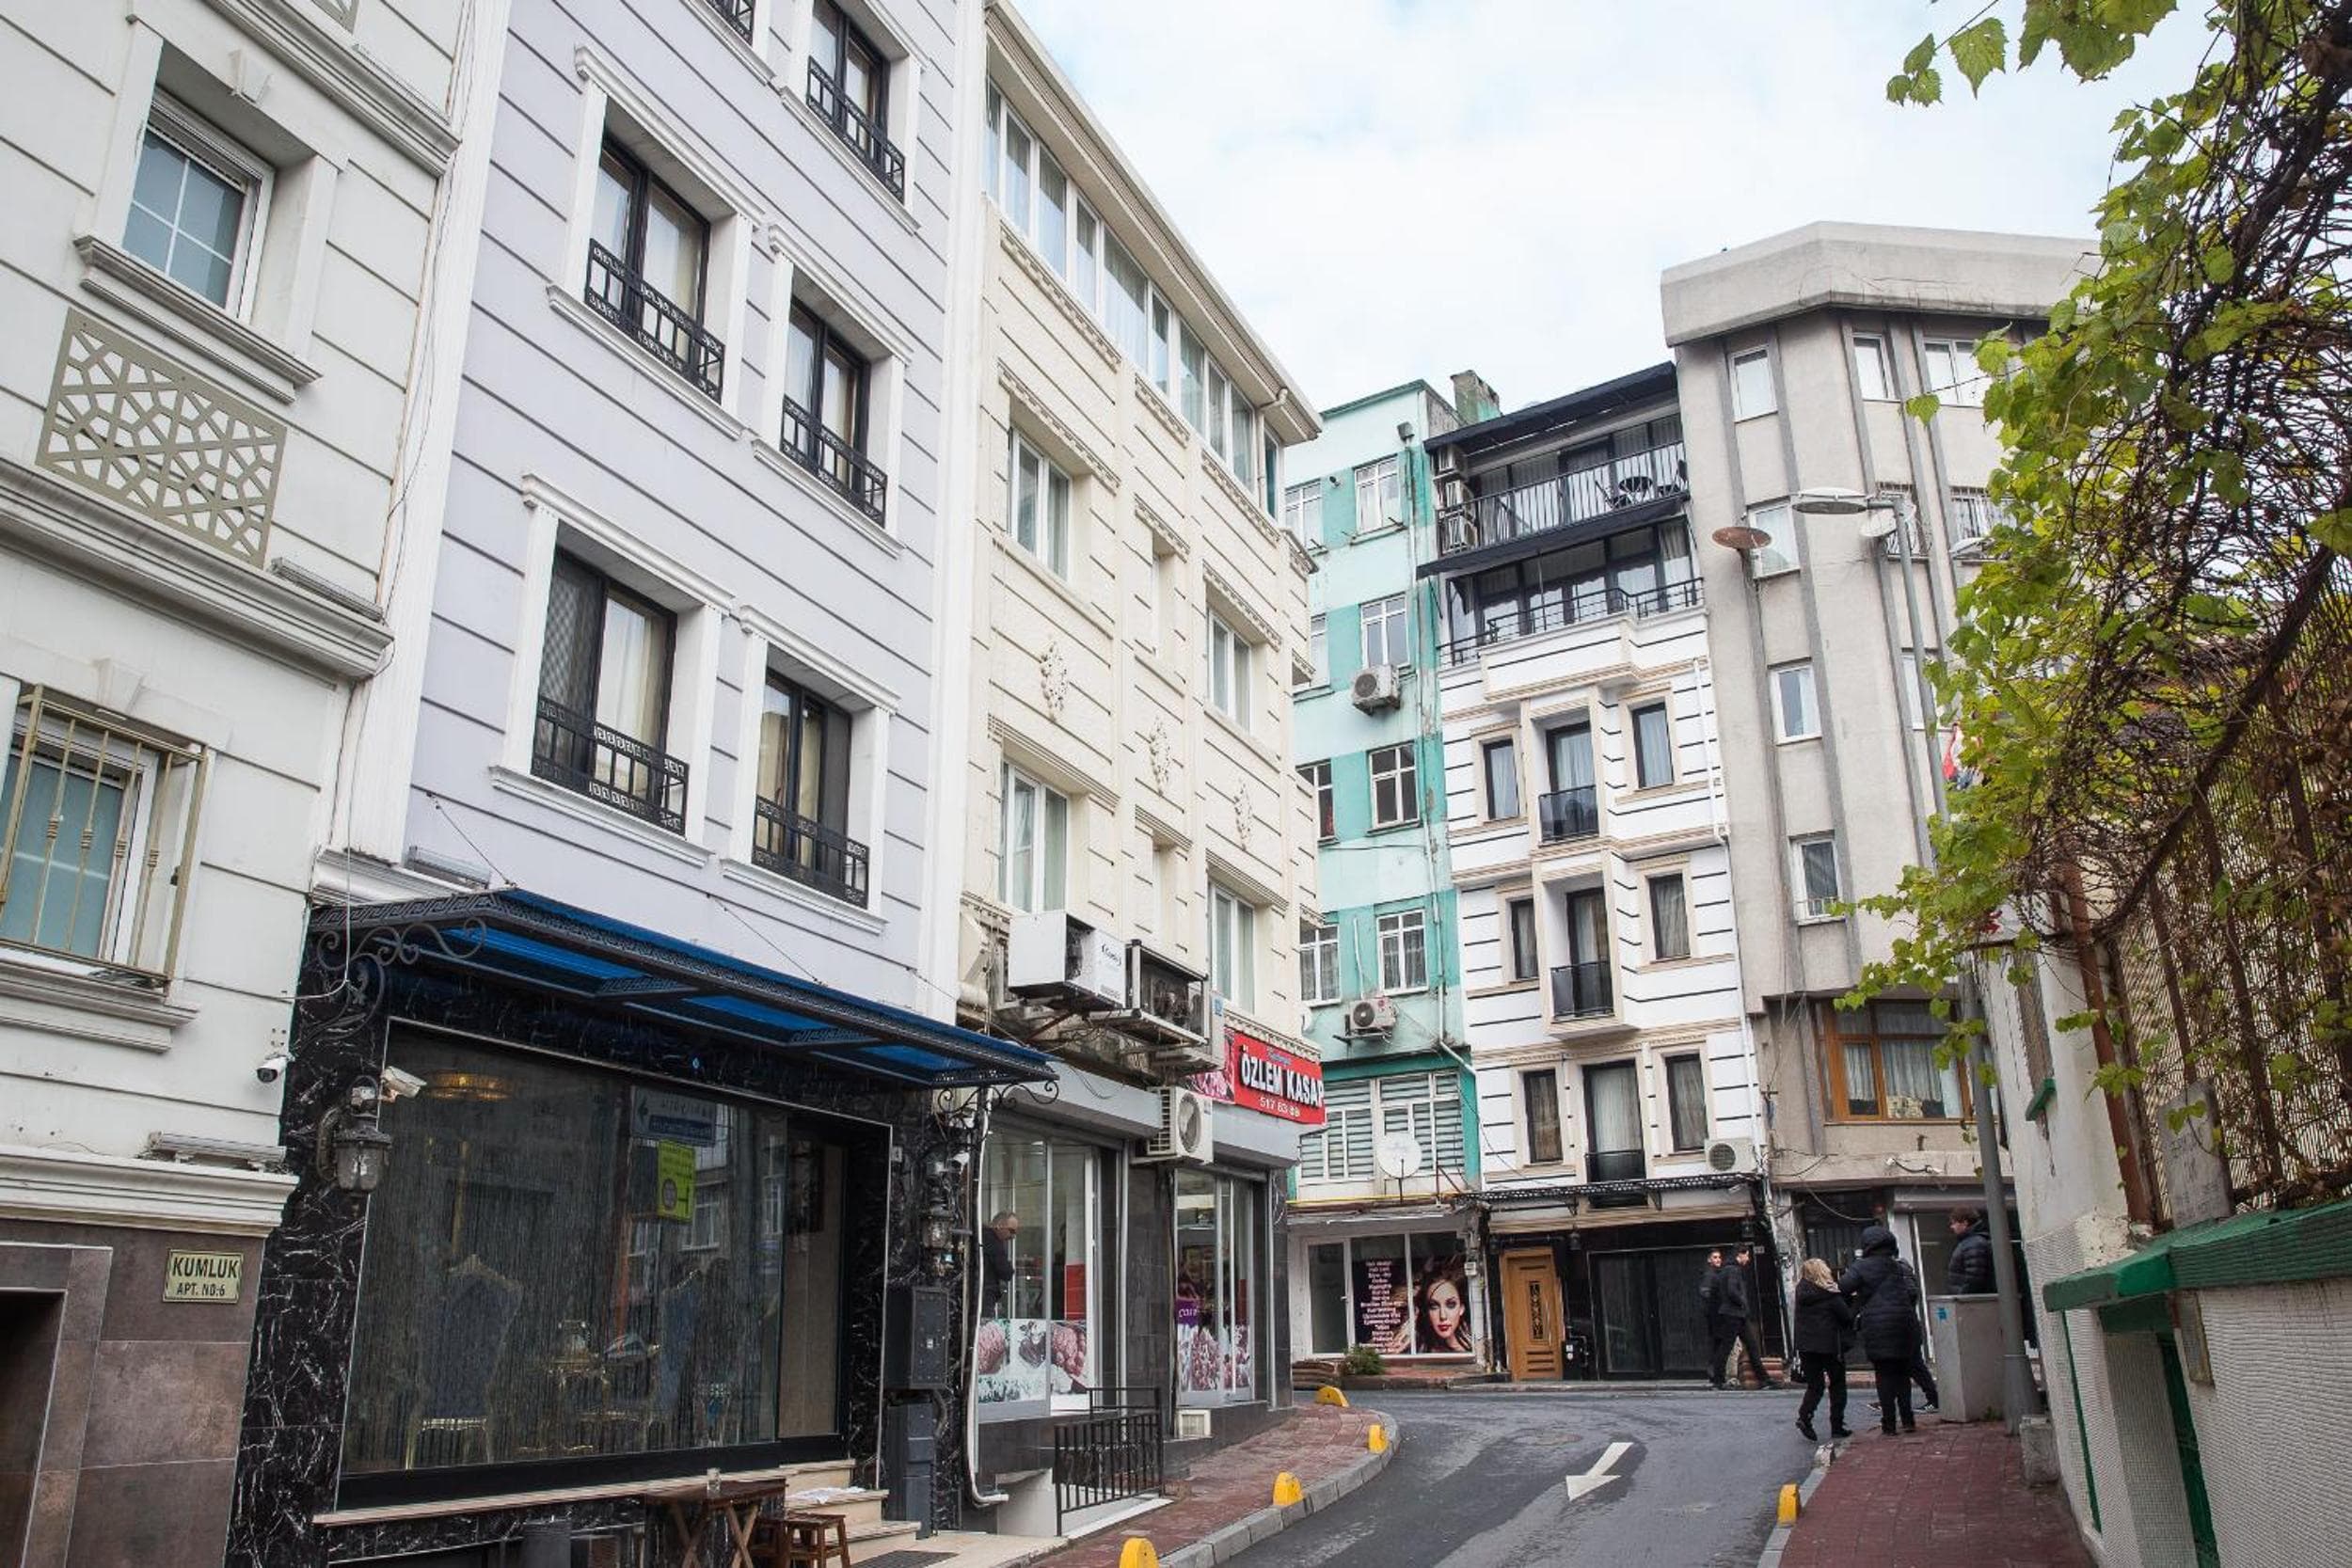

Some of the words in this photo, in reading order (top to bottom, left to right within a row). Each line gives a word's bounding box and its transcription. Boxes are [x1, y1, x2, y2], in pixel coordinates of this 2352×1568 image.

[1241, 1044, 1283, 1098] ÖZLEM
[1286, 1068, 1325, 1108] KASAP
[1259, 1097, 1275, 1110] 517
[172, 1257, 239, 1278] KUMLUK
[176, 1282, 199, 1296] APT.
[201, 1284, 226, 1296] NO:6
